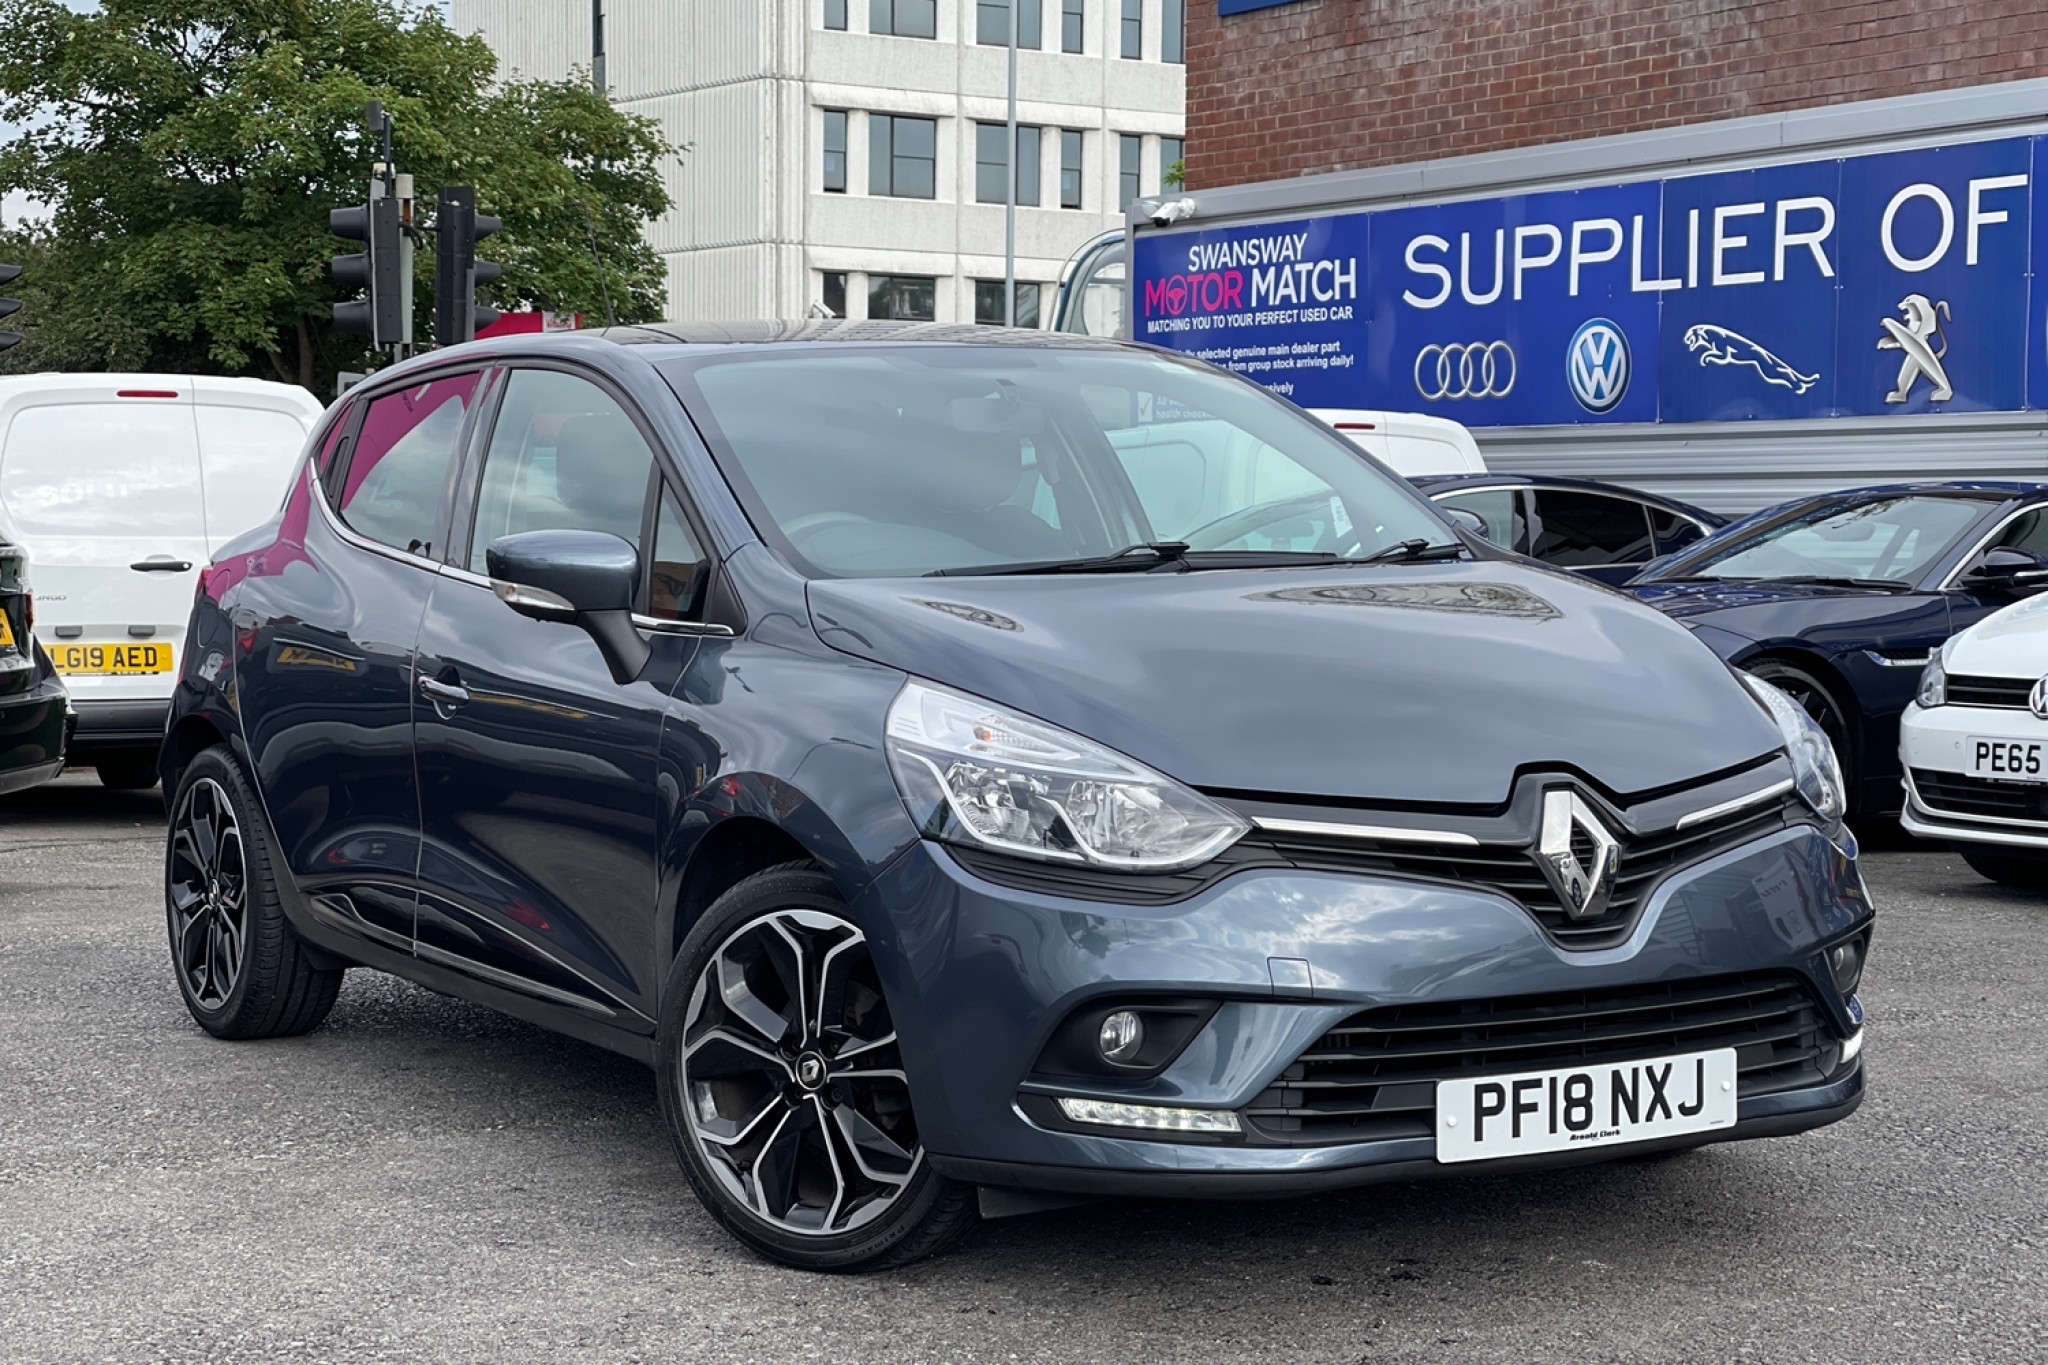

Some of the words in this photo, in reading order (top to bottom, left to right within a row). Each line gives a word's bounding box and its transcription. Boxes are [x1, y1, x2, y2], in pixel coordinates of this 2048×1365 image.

[1188, 232, 1308, 272] SWANSWAY
[1402, 195, 1836, 309] SUPPLIER
[1881, 174, 2029, 272] OF
[1145, 270, 1243, 316] MOTOR
[1251, 258, 1356, 307] MATCH
[1147, 317, 1190, 333] MATCHING
[1192, 316, 1212, 330] YOU
[1213, 315, 1226, 328] TO
[1227, 314, 1253, 327] YOUR
[1255, 310, 1298, 325] PERFECT
[1300, 307, 1328, 322] USED
[1330, 306, 1353, 320] CAR
[1197, 346, 1231, 360] selected
[1232, 345, 1267, 360] genuine
[1268, 343, 1290, 356] main
[1291, 341, 1319, 354] dealer
[1321, 340, 1340, 356] part
[1229, 360, 1247, 372] from
[1248, 358, 1271, 373] group
[1272, 356, 1295, 369] stock
[1296, 355, 1328, 371] arriving
[1330, 354, 1354, 368] daily!
[50, 647, 104, 668] LG19
[113, 646, 157, 667] AED
[1975, 741, 2041, 774] PE65
[1474, 1073, 1594, 1142] PF18
[1610, 1058, 1704, 1127] NXJ
